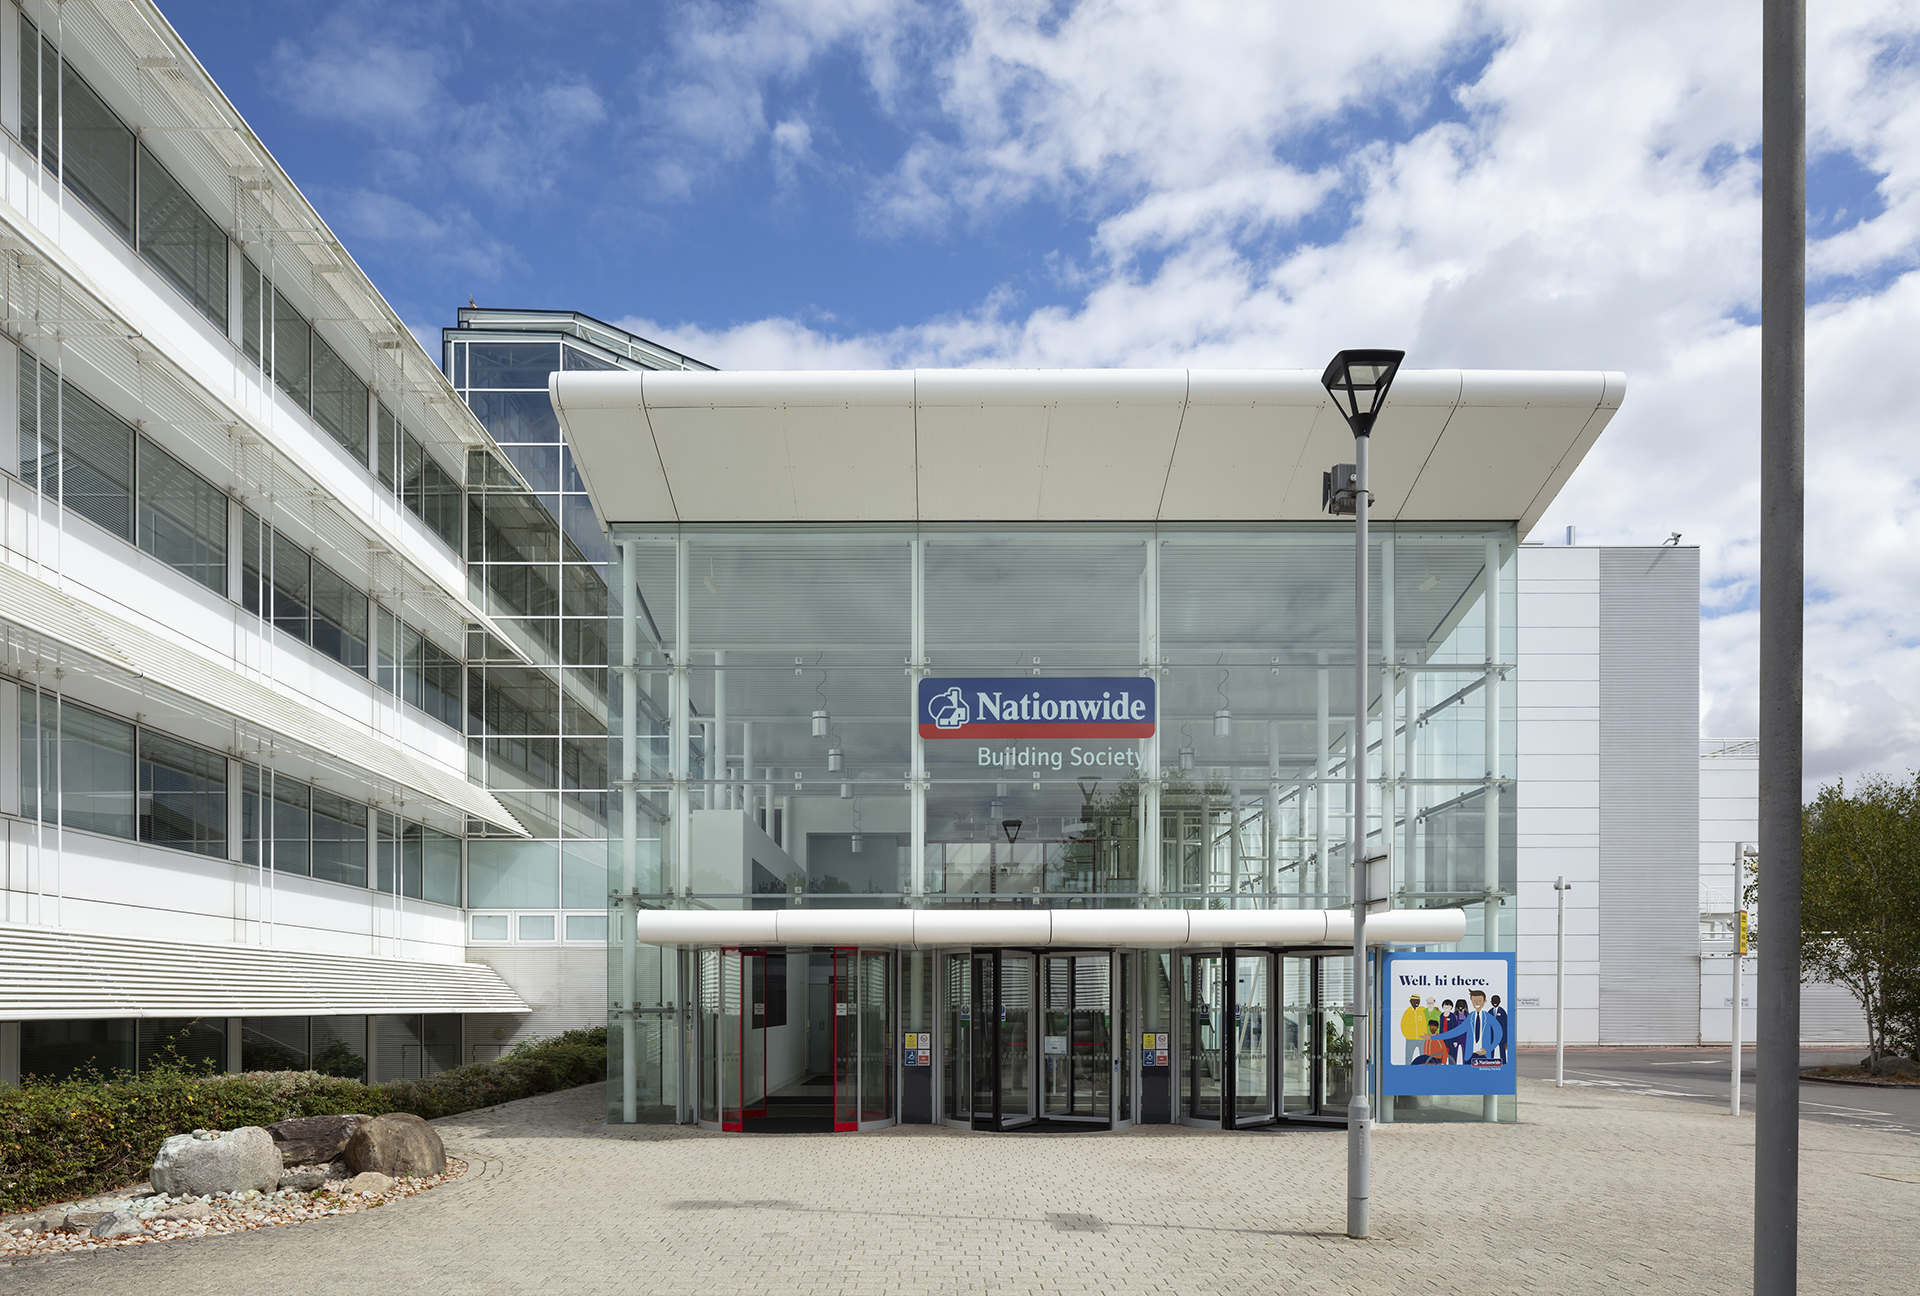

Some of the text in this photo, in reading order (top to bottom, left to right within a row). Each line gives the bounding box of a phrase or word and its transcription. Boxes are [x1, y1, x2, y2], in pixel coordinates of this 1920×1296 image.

[976, 691, 1146, 721] Nationwide
[978, 746, 1147, 770] Building Society
[1399, 975, 1489, 986] Well, hi there.
